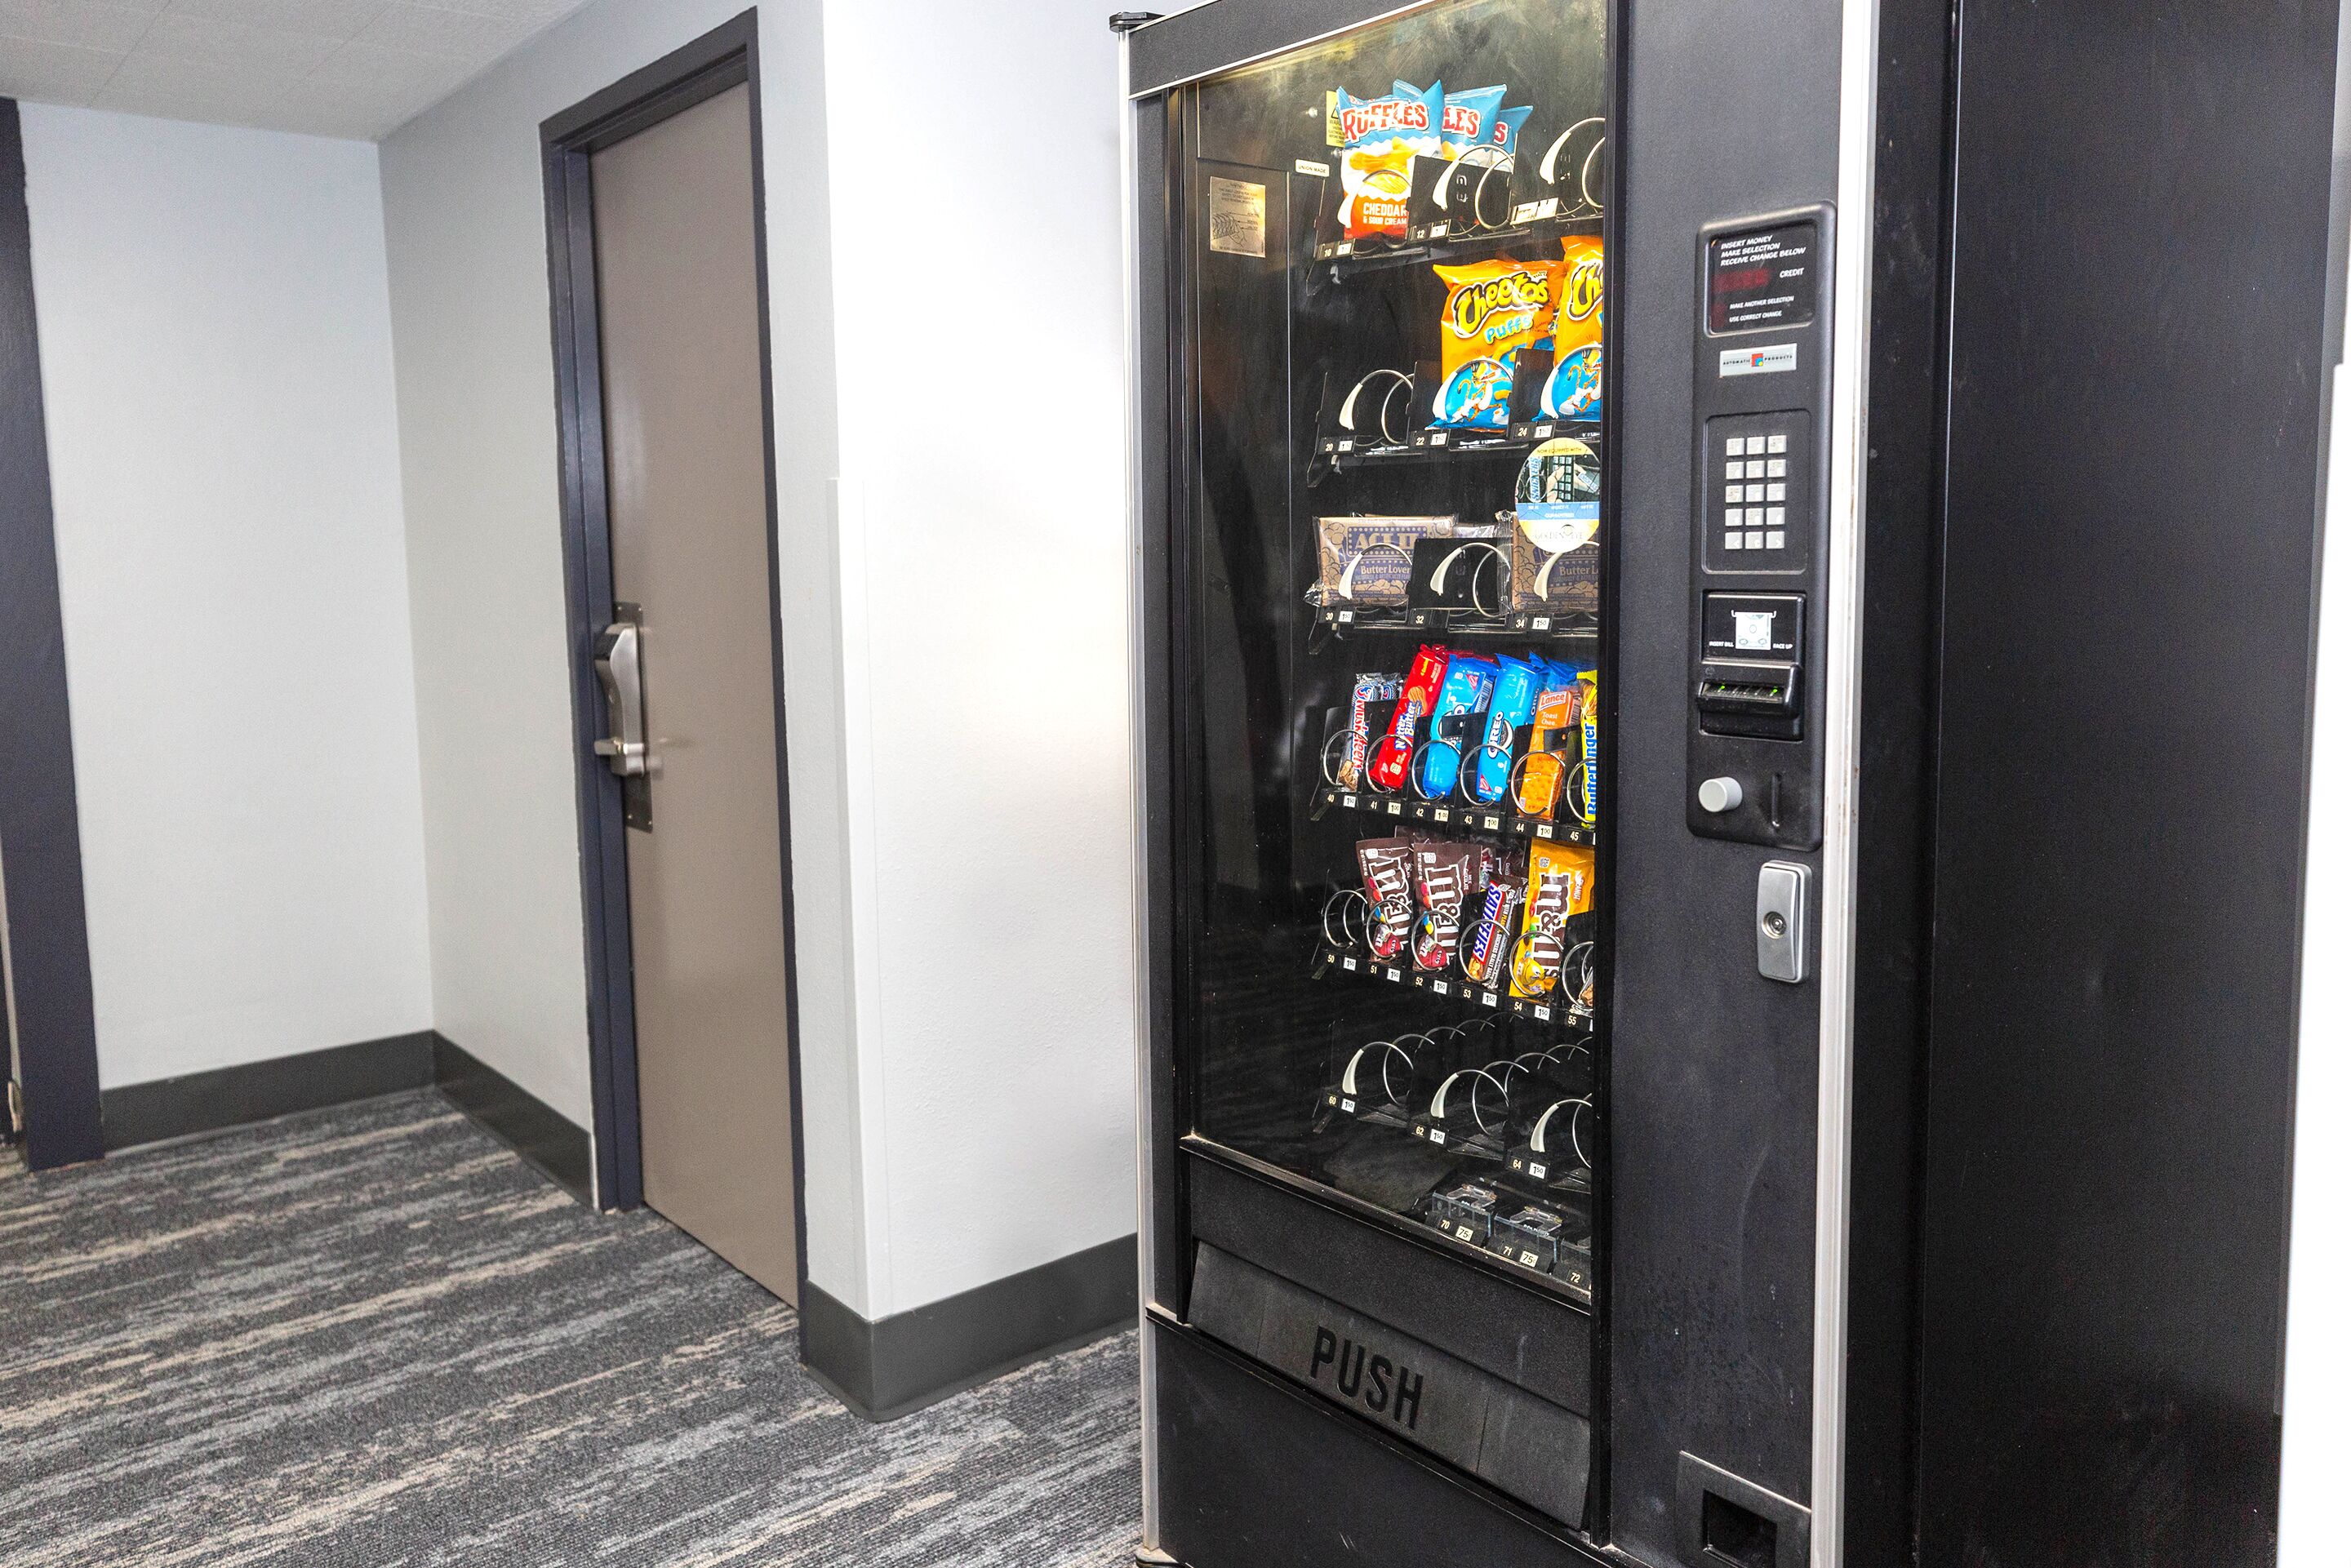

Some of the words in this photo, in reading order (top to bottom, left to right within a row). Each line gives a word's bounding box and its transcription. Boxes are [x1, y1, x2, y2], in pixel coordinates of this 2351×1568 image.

[1342, 102, 1427, 140] RUFFLES
[1363, 202, 1407, 217] CHEDDAR
[1368, 216, 1384, 224] SOUR
[1384, 217, 1407, 225] CREAM
[1417, 229, 1424, 238] 12
[1721, 239, 1746, 250] INSERT
[1747, 235, 1772, 245] MONEY
[1324, 249, 1331, 257] 10
[1721, 249, 1740, 258] MAKE
[1742, 242, 1780, 255] SELECTION
[1721, 256, 1749, 266] RECEIVE
[1749, 251, 1778, 261] CHANGE
[1780, 247, 1806, 257] BELOW
[1780, 268, 1804, 278] CREDIT
[1455, 271, 1549, 334] Cheetos
[1767, 295, 1794, 304] SELECTION
[1740, 313, 1762, 322] CORRECT
[1762, 310, 1782, 318] CHANGE
[1518, 427, 1527, 437] 24
[1416, 437, 1424, 446] 22
[1325, 443, 1333, 451] 20
[1361, 565, 1387, 575] Butter
[1559, 566, 1590, 575] Butter
[1325, 612, 1333, 620] 30
[1415, 615, 1424, 624] 32
[1516, 619, 1525, 629] 34
[1540, 693, 1565, 707] Lance
[1405, 702, 1416, 736] Butter
[1542, 711, 1558, 719] Toast
[1487, 711, 1504, 759] OREO
[1327, 793, 1335, 802] 40
[1371, 801, 1378, 810] 41
[1416, 808, 1424, 817] 42
[1464, 815, 1473, 824] 43
[1516, 823, 1525, 833] 44
[1570, 832, 1579, 842] 45
[1327, 954, 1335, 963] 50
[1371, 966, 1378, 975] 51
[1415, 977, 1423, 986] 52
[1463, 988, 1471, 998] 53
[1514, 1002, 1522, 1011] 54
[1568, 1015, 1576, 1025] 55
[1328, 1096, 1337, 1106] 60
[1415, 1126, 1424, 1136] 62
[1513, 1160, 1522, 1170] 64
[1441, 1219, 1451, 1229] 70
[1503, 1246, 1512, 1256] 71
[1570, 1273, 1580, 1283] 72
[1310, 1326, 1424, 1429] PUSH
